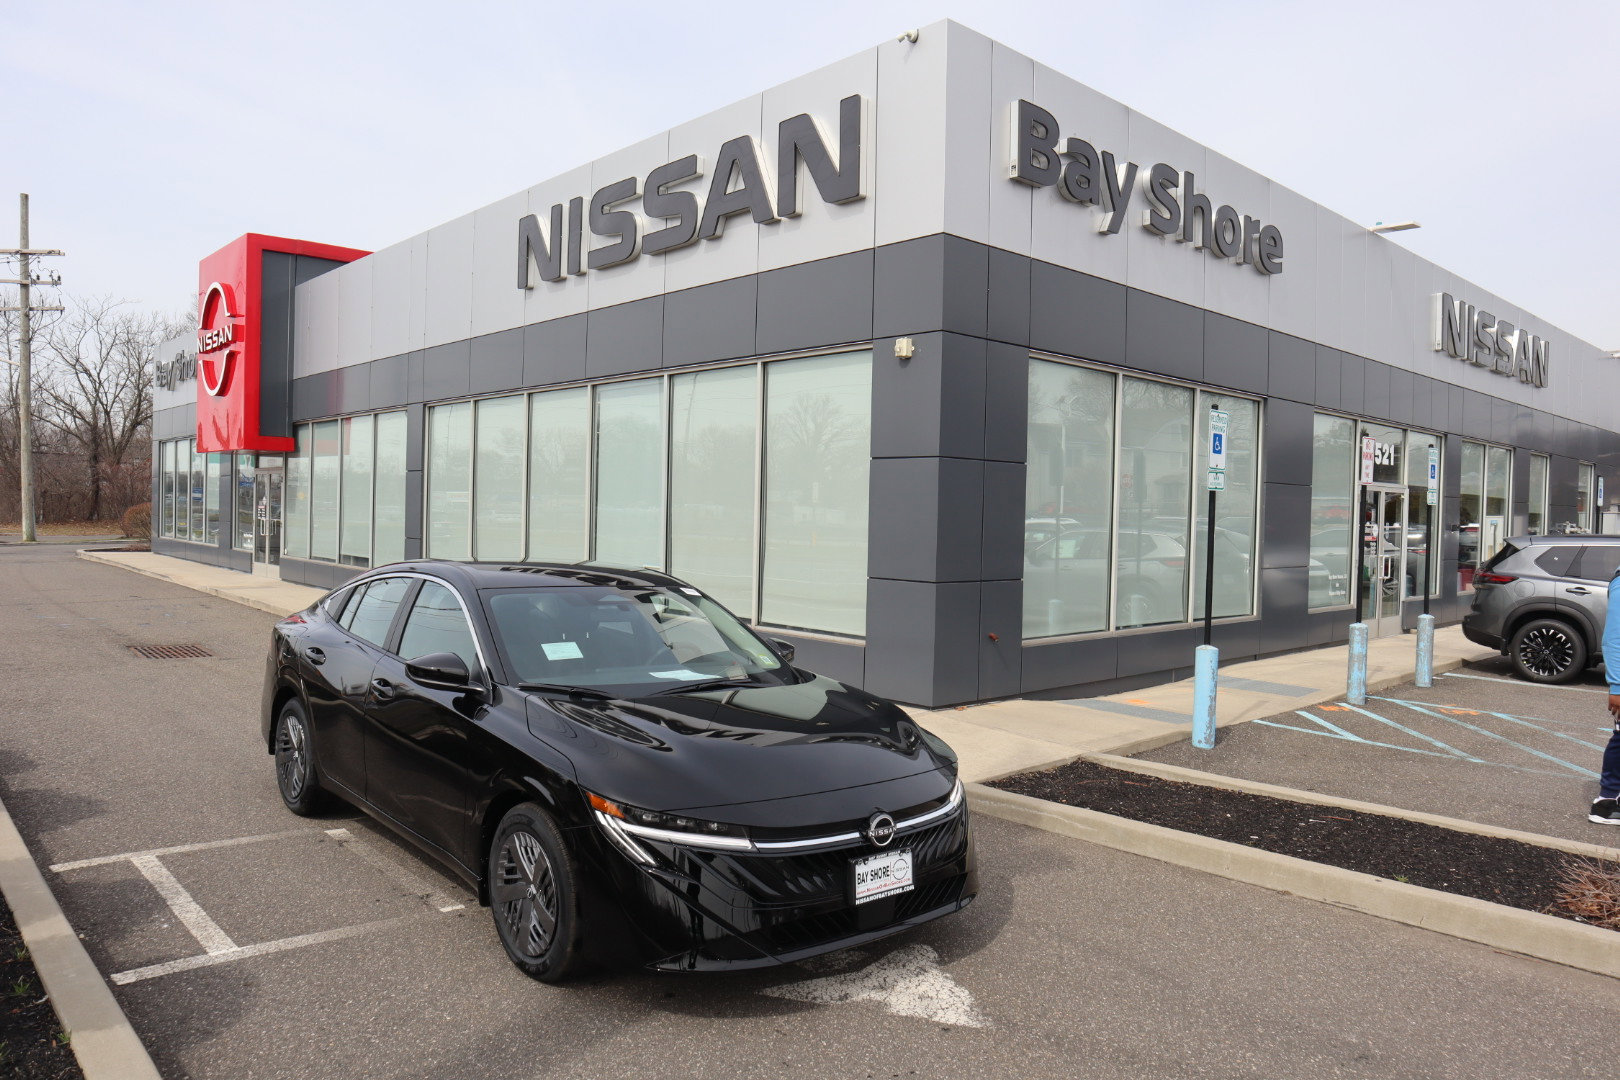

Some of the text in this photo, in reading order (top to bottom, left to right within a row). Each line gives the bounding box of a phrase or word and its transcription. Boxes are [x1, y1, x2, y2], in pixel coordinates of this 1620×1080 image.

[517, 93, 867, 289] NISSAN
[1009, 98, 1283, 275] Bay Shore
[197, 323, 233, 353] NISSAN
[1435, 291, 1549, 388] NISSAN
[156, 349, 198, 391] Bay Sho
[1375, 442, 1395, 466] 521
[869, 826, 897, 837] NISSAN
[857, 871, 869, 885] BAY
[870, 865, 890, 882] SHORE
[855, 885, 915, 905] NISSANOFBAYSHORE.COM
